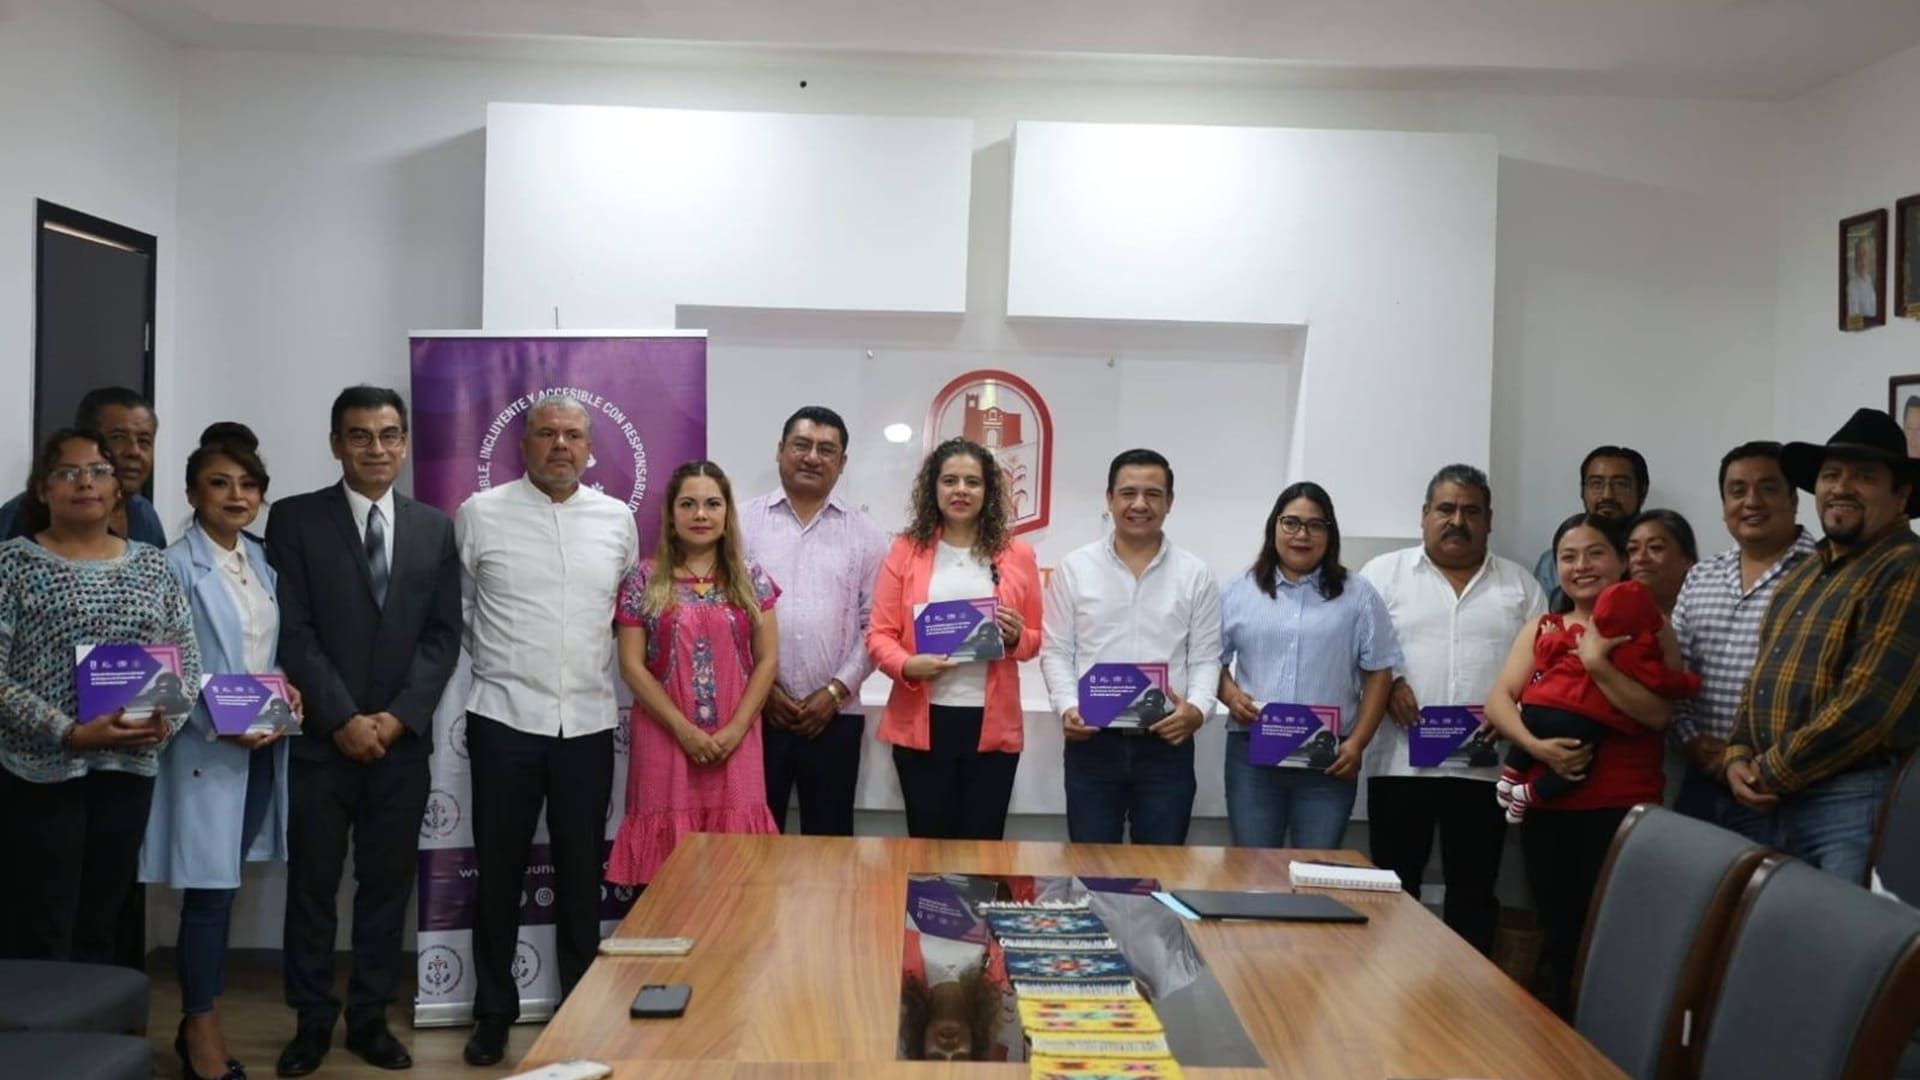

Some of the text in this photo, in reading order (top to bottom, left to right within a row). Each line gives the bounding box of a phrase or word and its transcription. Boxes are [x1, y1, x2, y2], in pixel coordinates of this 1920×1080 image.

[480, 399, 528, 459] INCLUYENTE
[538, 387, 604, 409] ACCESIBLE
[602, 402, 627, 425] CON
[621, 422, 648, 513] RESPONSABILID
